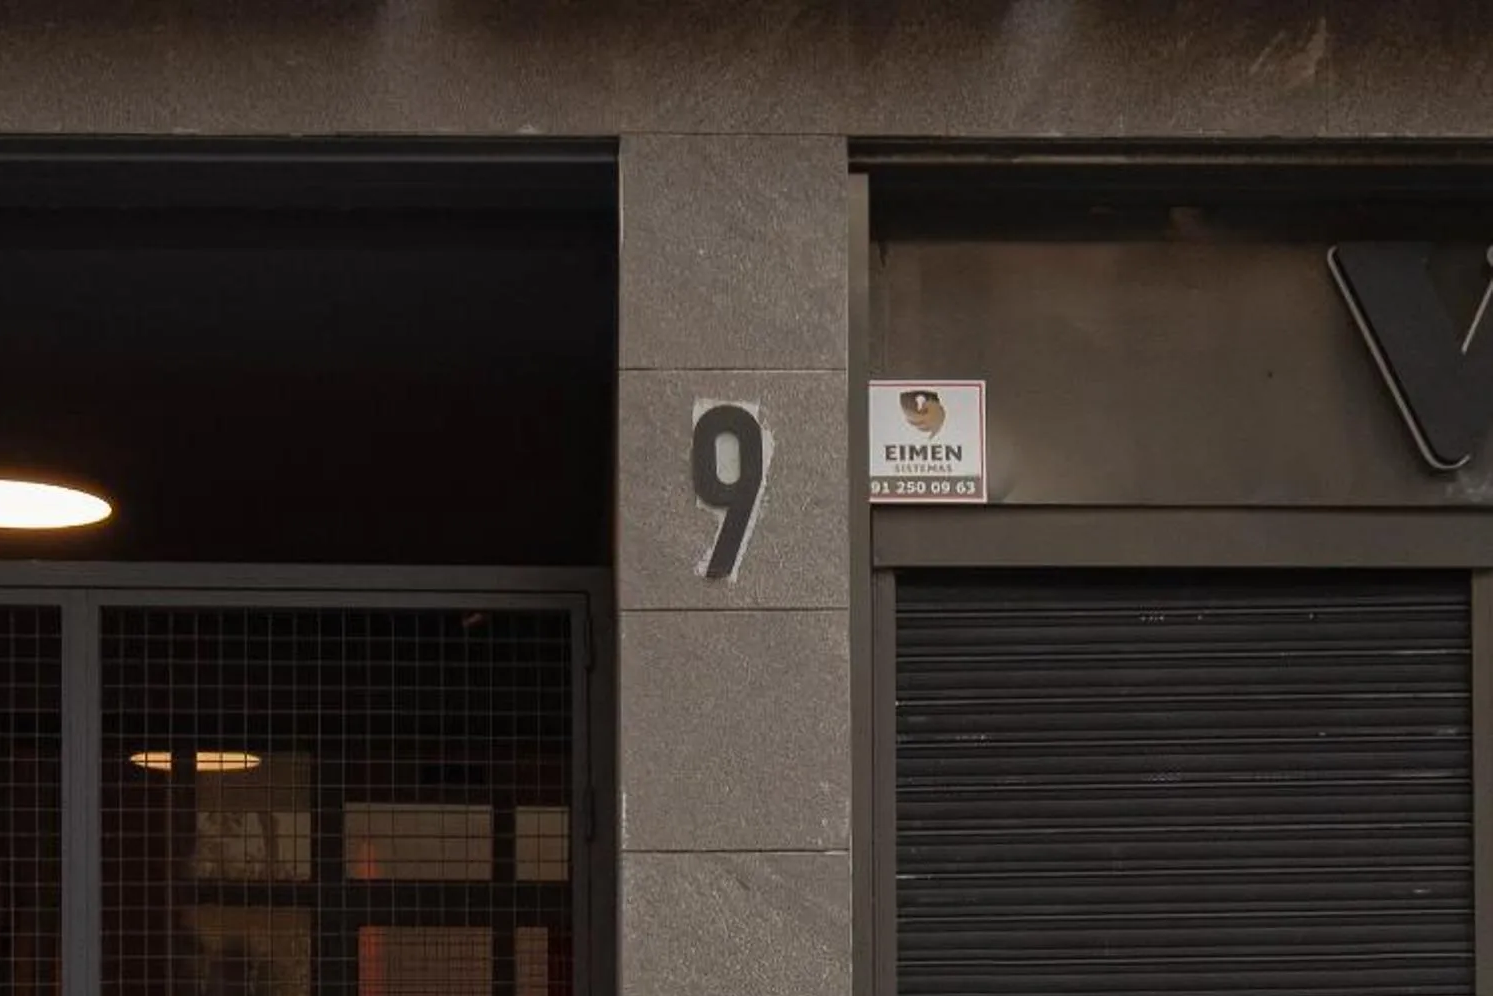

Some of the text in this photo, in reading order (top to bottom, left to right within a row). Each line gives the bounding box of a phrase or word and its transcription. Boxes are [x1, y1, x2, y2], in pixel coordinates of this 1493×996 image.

[885, 445, 963, 461] EIMEN
[894, 464, 953, 473] SISTEMAS
[692, 404, 763, 578] 9
[870, 481, 976, 494] 91 250 09 63
